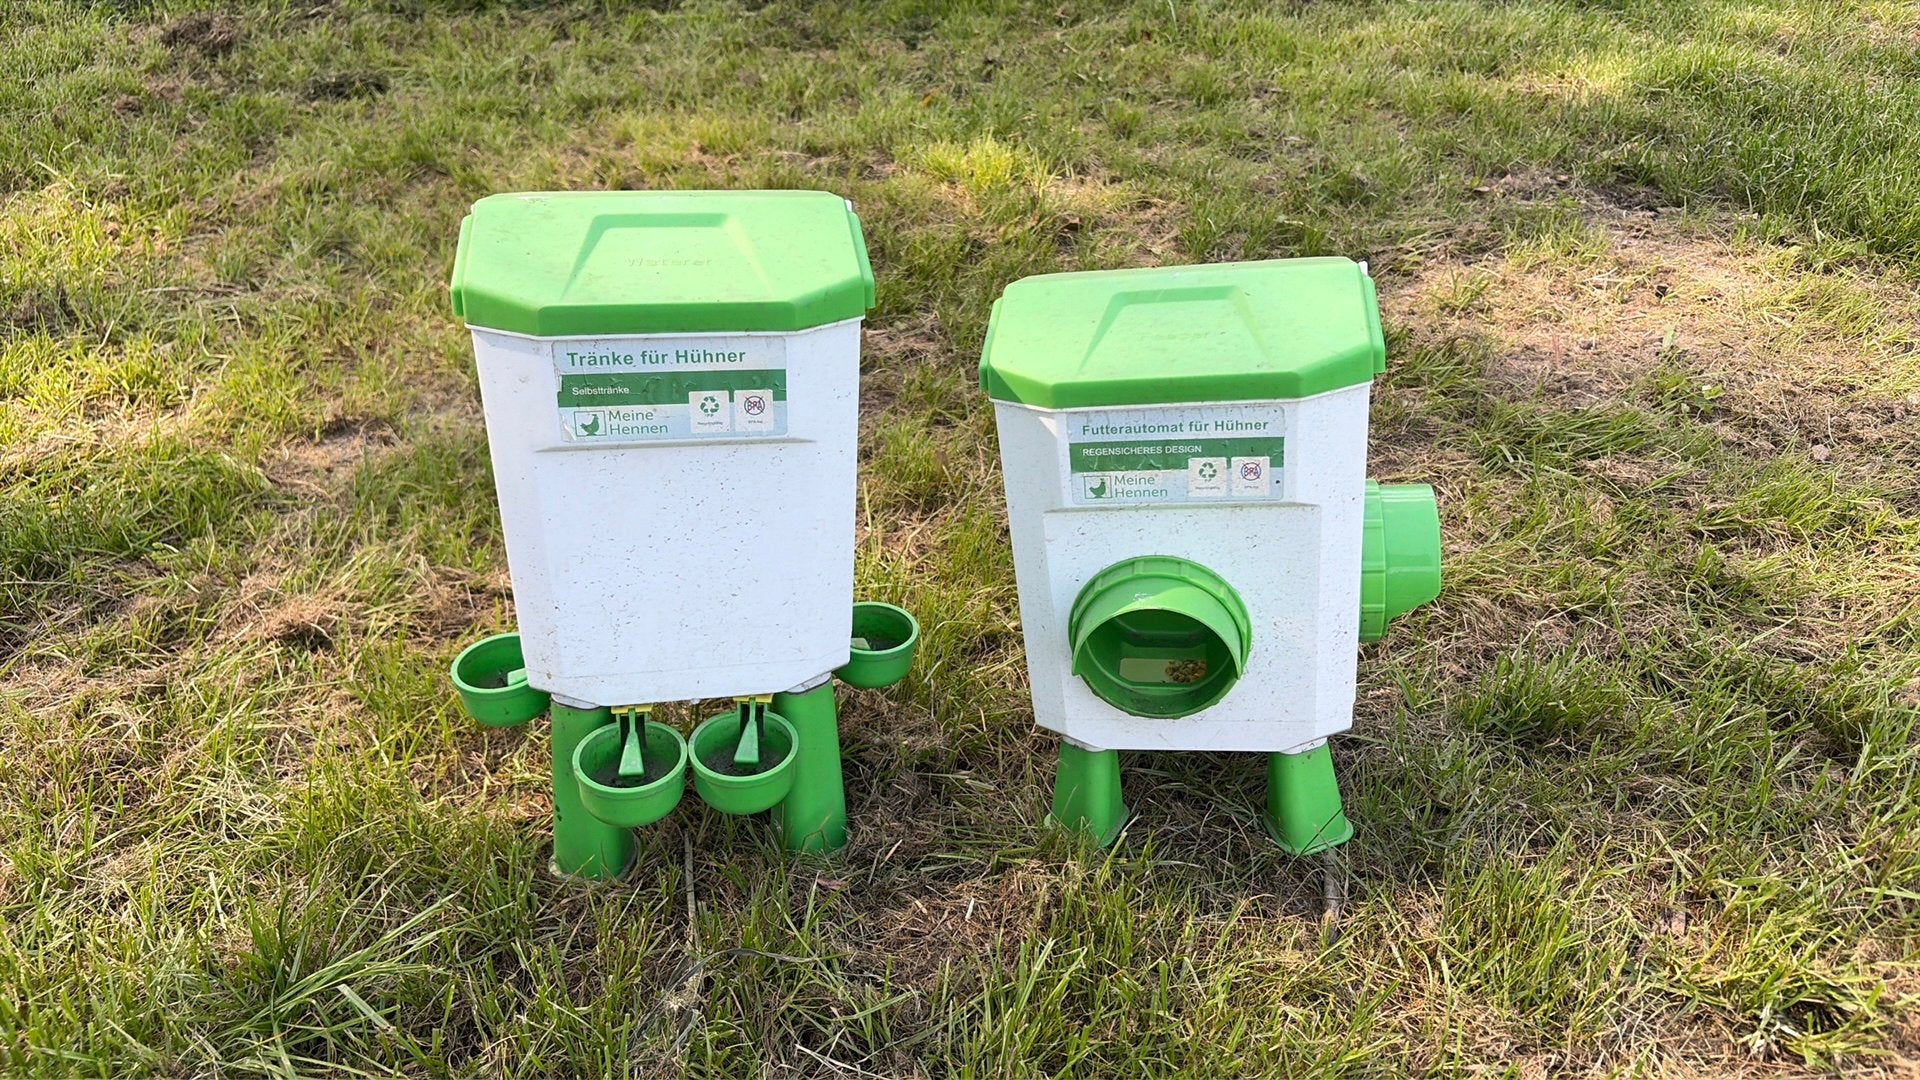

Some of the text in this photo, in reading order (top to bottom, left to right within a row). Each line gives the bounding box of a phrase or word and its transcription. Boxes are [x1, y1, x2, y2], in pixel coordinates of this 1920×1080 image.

[567, 349, 746, 367] Tränke für Hühner
[572, 386, 630, 396] Selbsttränke
[608, 410, 654, 422] Meine
[609, 423, 669, 435] Hennen
[1082, 420, 1269, 435] Futterautomat für Hühner
[1082, 445, 1202, 456] REGENSICHERES DESIGN
[1114, 475, 1155, 486] Meine
[1114, 487, 1168, 498] Hennen
